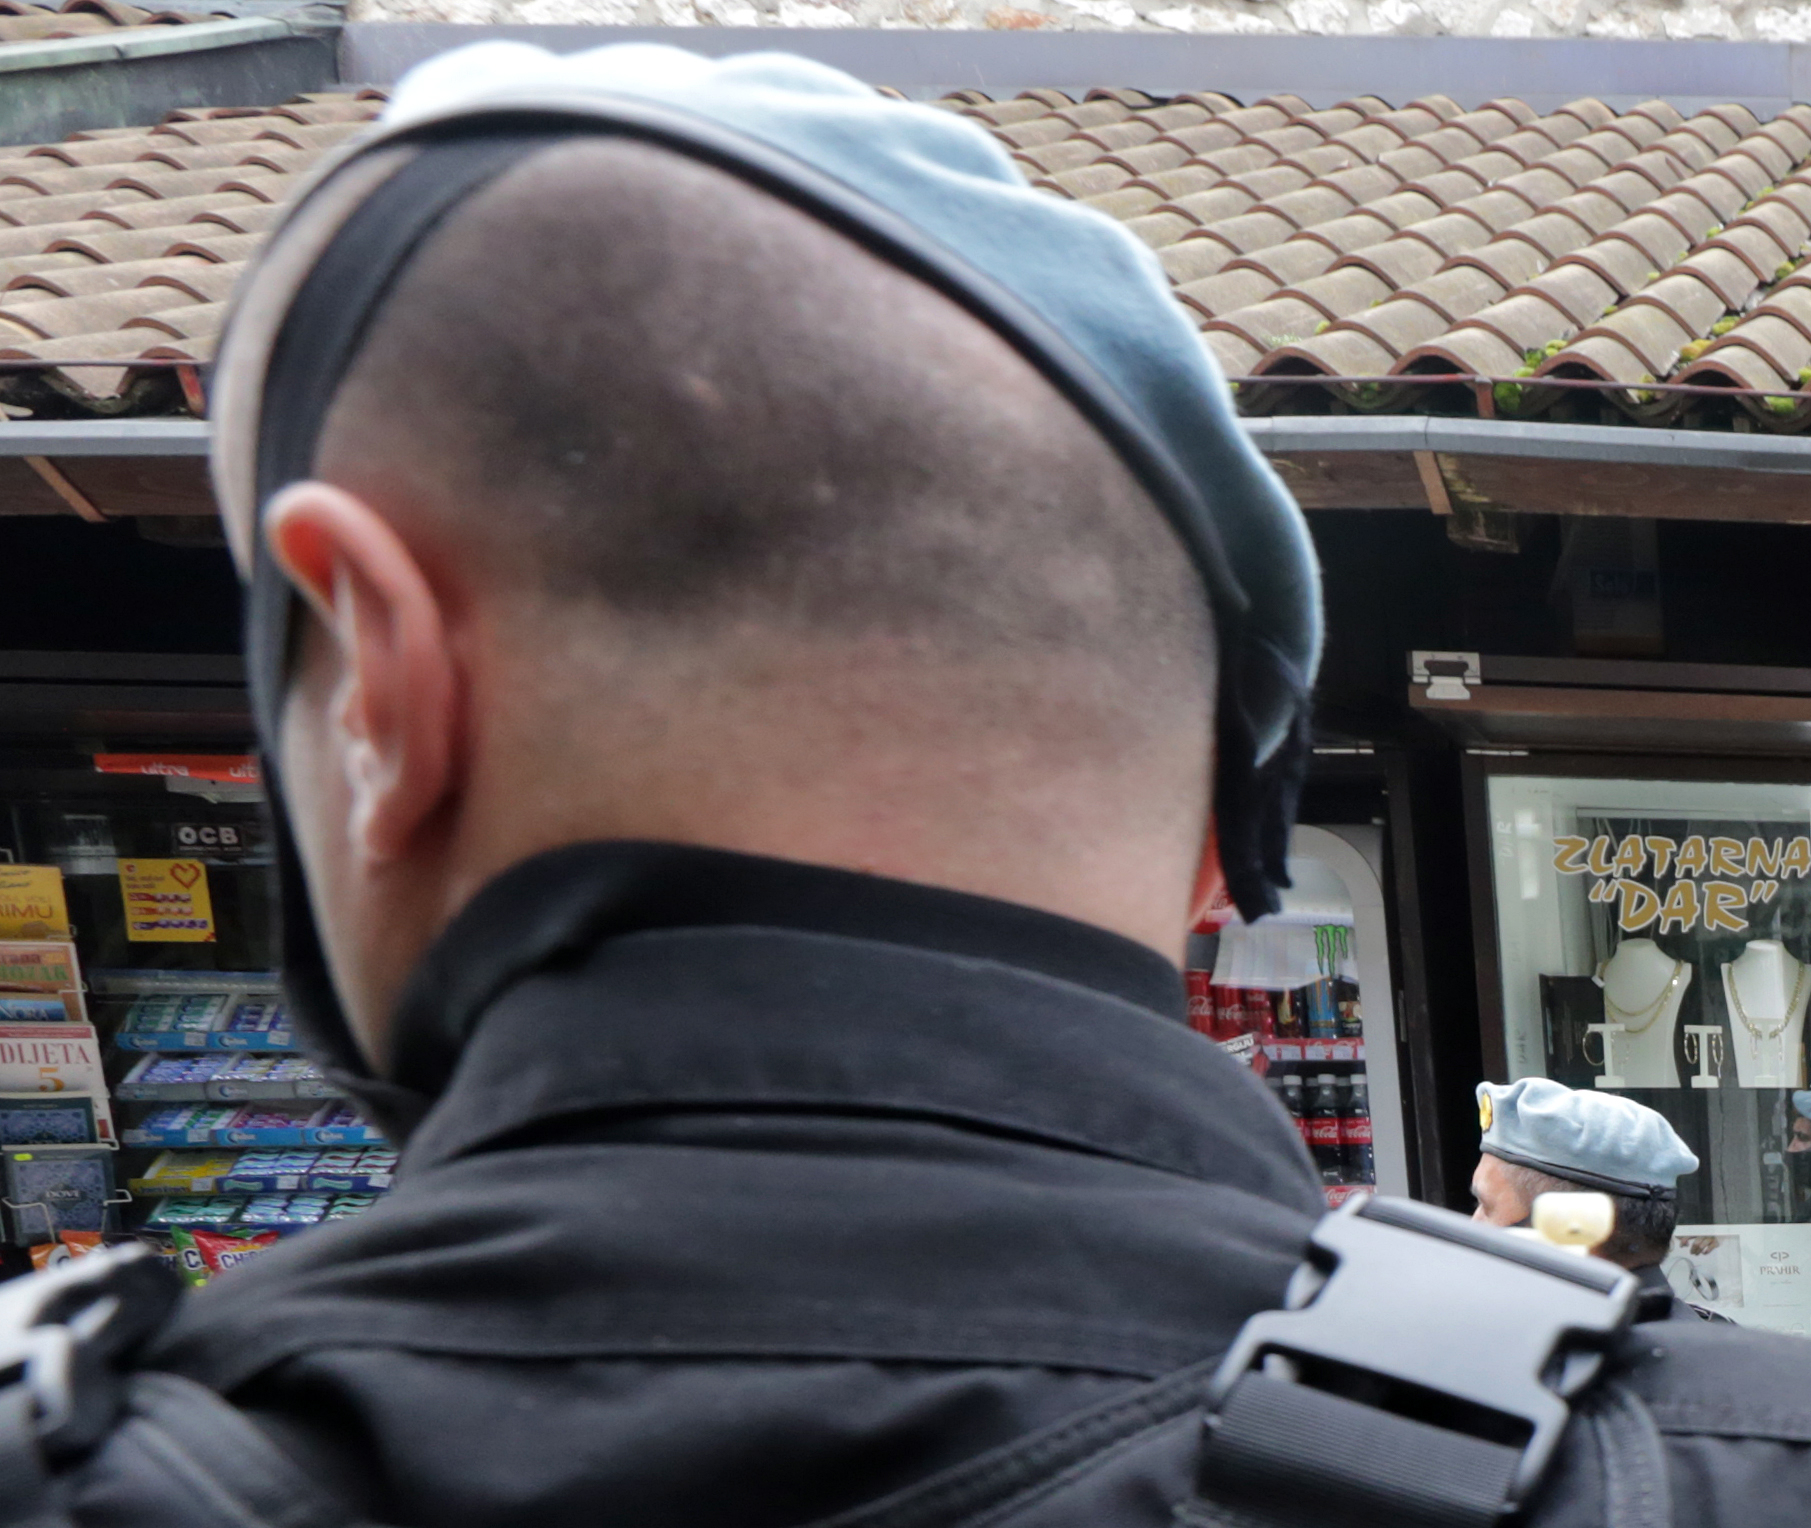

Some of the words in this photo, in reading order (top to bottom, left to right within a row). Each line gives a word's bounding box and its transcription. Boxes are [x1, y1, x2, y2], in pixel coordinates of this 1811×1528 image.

[177, 826, 239, 845] OCB
[1553, 835, 1811, 879] ZLATARNA
[1588, 879, 1779, 934] "DAR"
[0, 1042, 92, 1065] DIJETA
[38, 1066, 65, 1093] 5
[1759, 1264, 1801, 1276] PRAHIR
